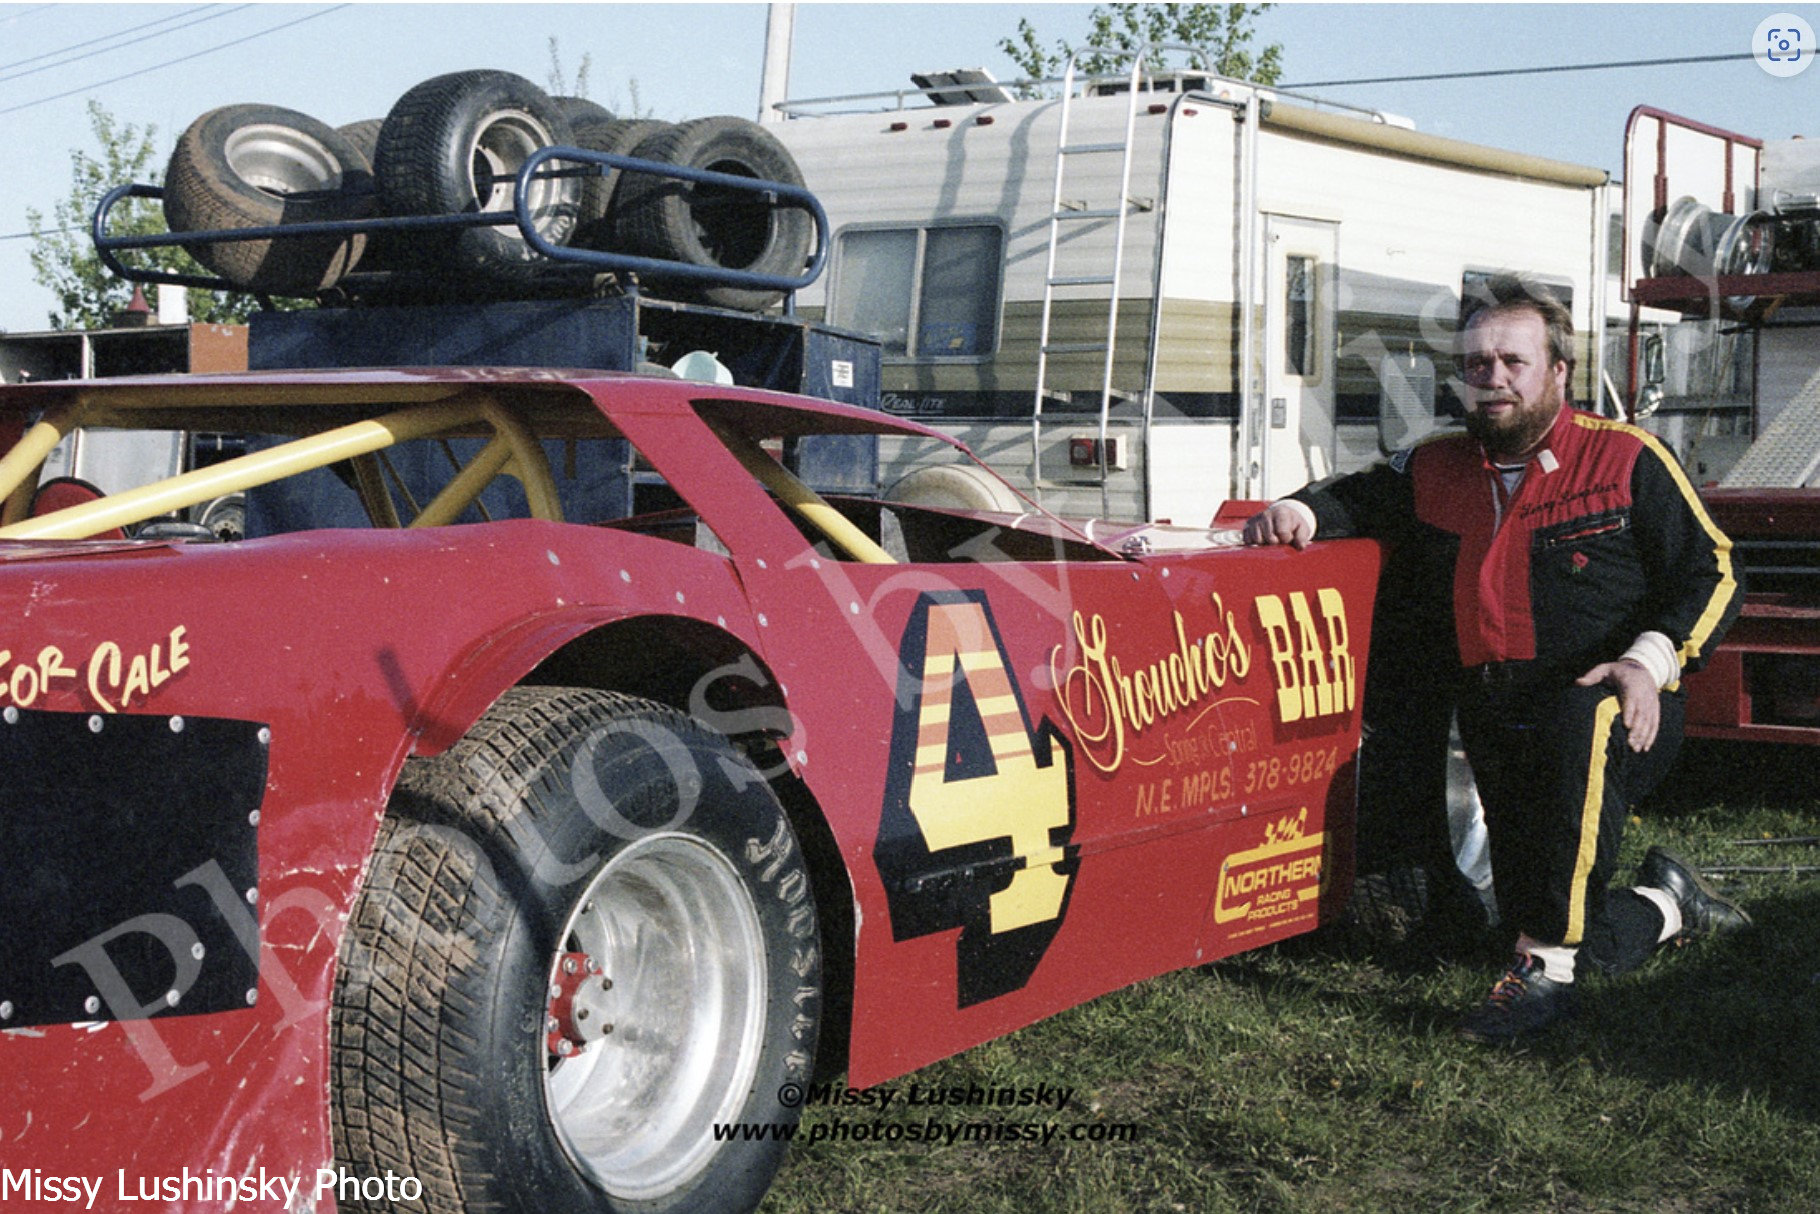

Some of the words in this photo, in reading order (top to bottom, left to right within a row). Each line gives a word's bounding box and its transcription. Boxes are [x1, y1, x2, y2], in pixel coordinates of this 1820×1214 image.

[1051, 591, 1251, 772] Groucho's
[1255, 587, 1355, 723] BAR
[896, 597, 1075, 950] 4
[1247, 899, 1299, 922] PRODUCTS
[1256, 888, 1292, 906] RACING
